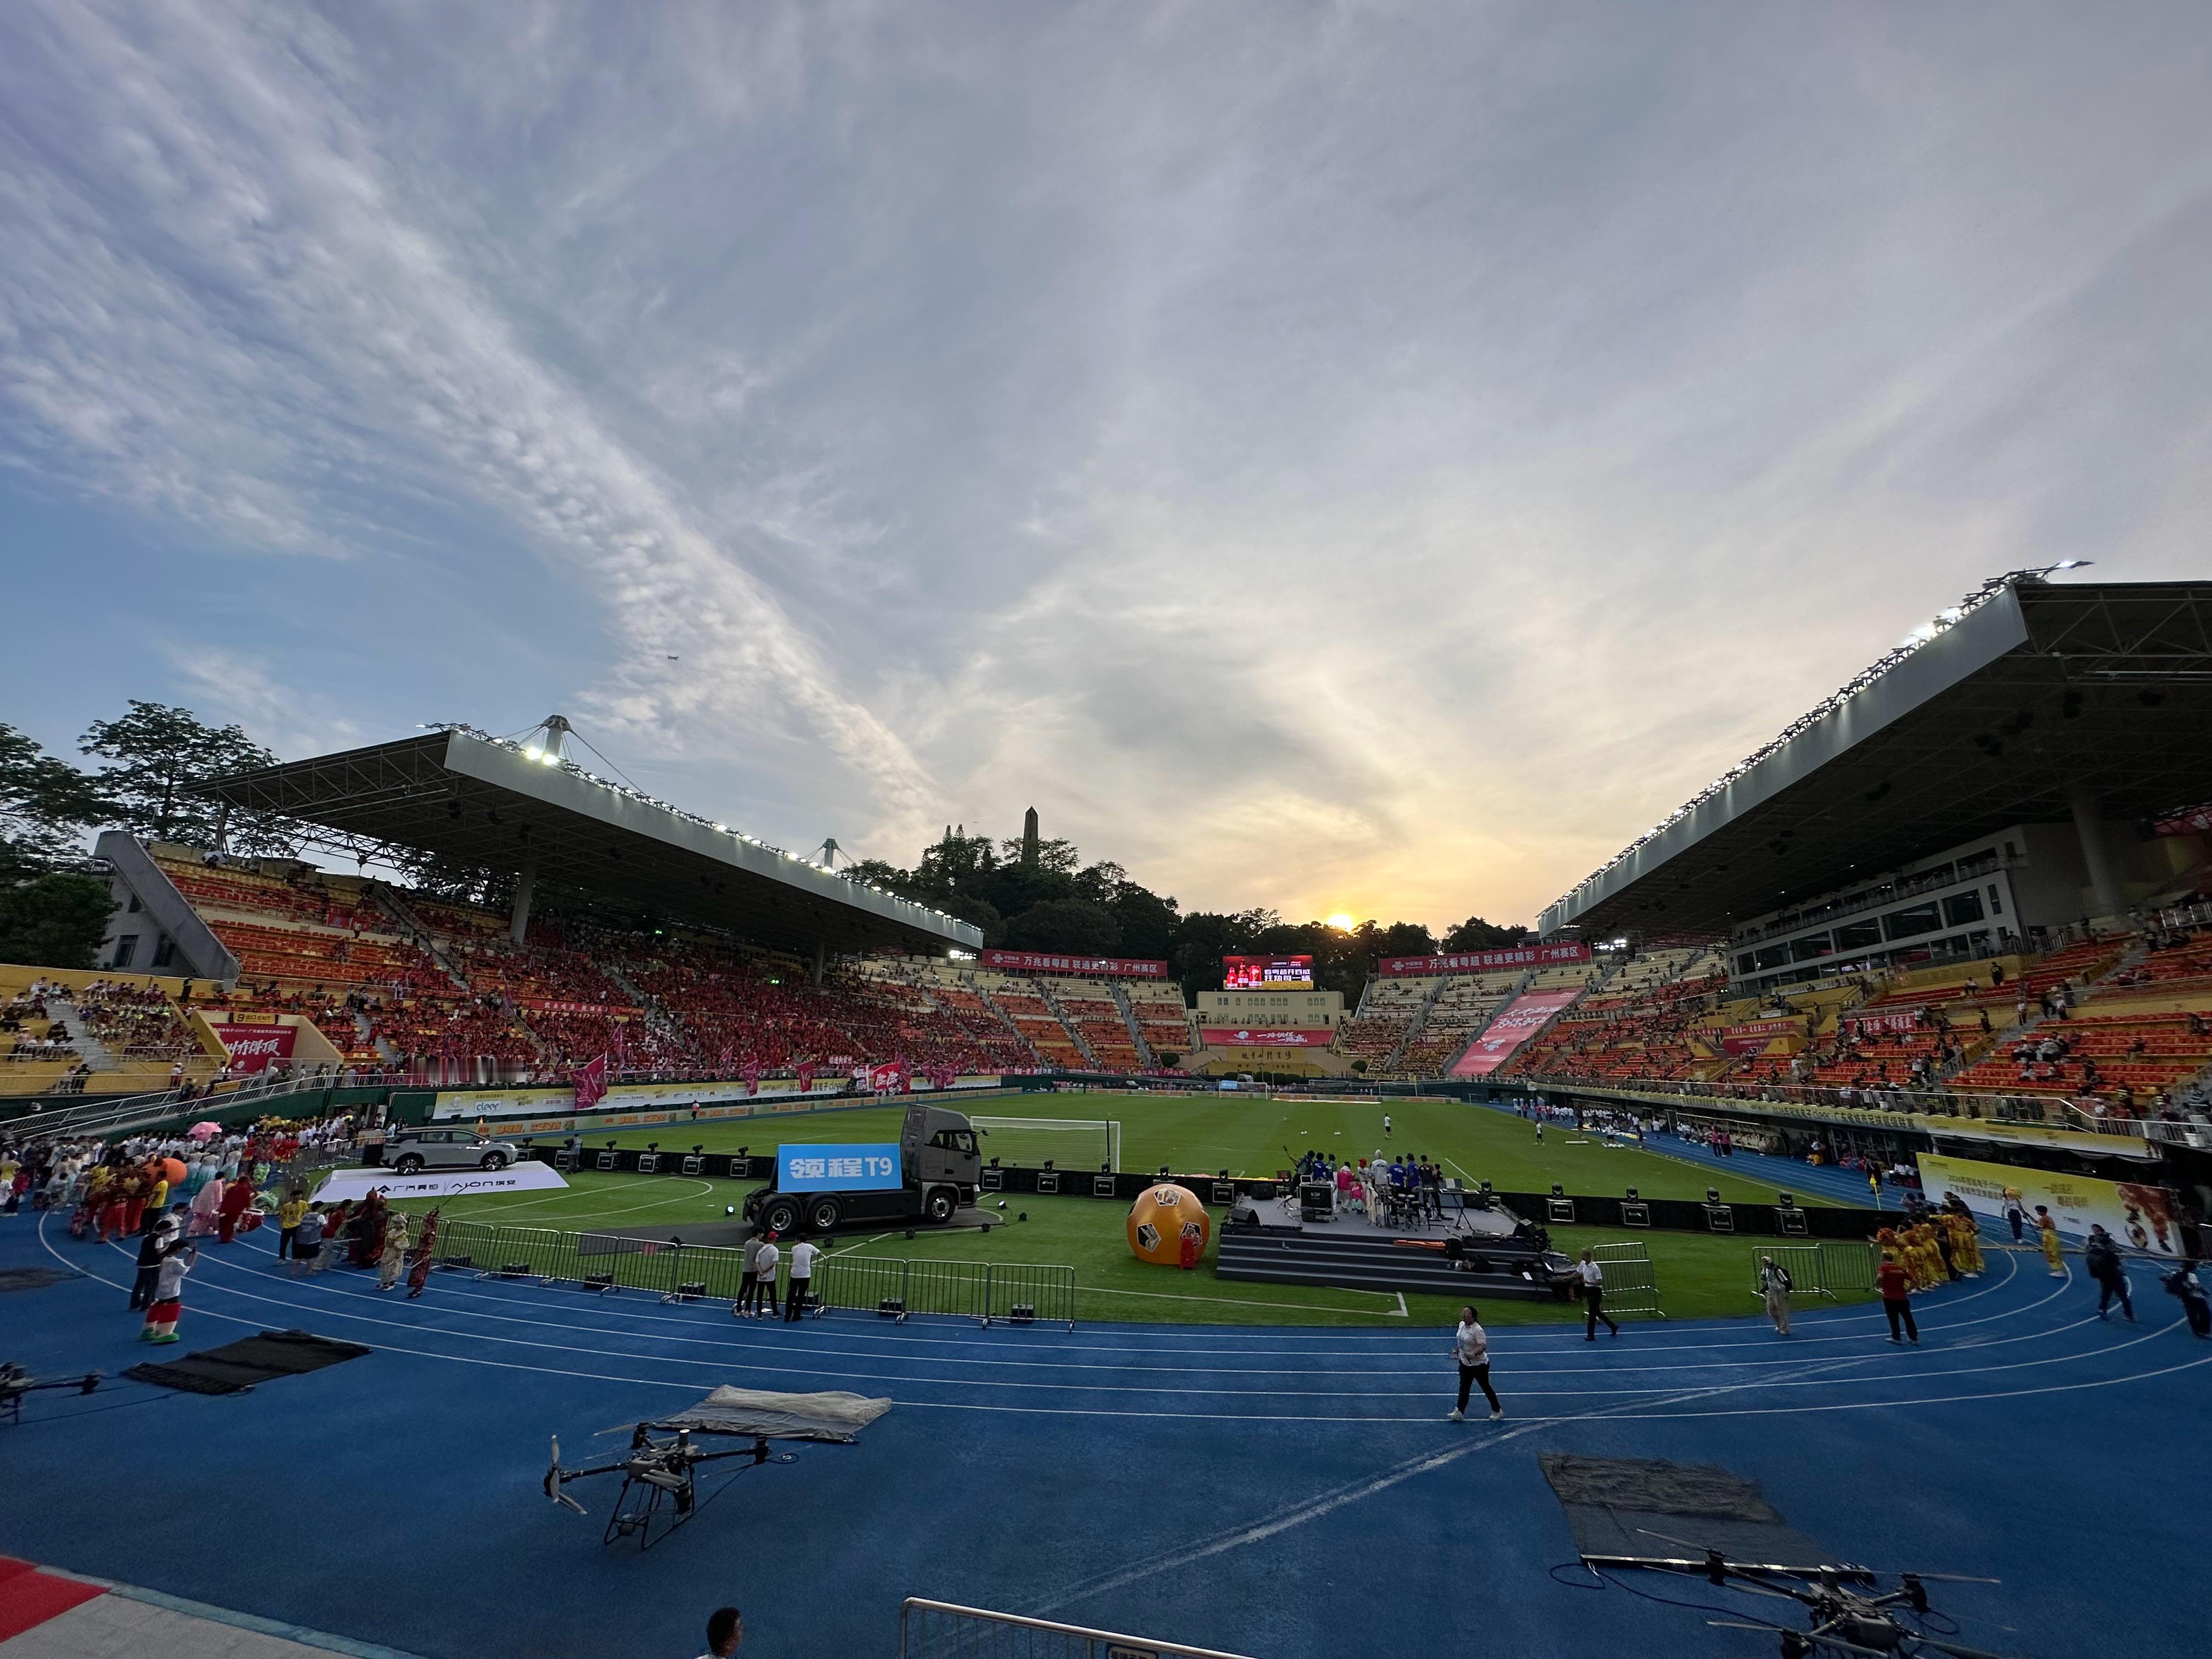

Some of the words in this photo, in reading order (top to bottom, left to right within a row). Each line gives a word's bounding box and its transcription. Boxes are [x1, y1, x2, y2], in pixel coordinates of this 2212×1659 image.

[1024, 956, 1069, 969] 万兆看粤超
[1123, 964, 1157, 973] 广州赛区
[1483, 950, 1536, 966] 联通更精彩
[1541, 946, 1579, 961] 广州赛区
[237, 1014, 245, 1022] 9
[476, 1102, 500, 1111] cleer
[1813, 1109, 1830, 1120] cleer
[1834, 1112, 1916, 1130] 广东省城市足球超级联赛
[789, 1158, 862, 1179] 领程
[865, 1157, 893, 1177] T9
